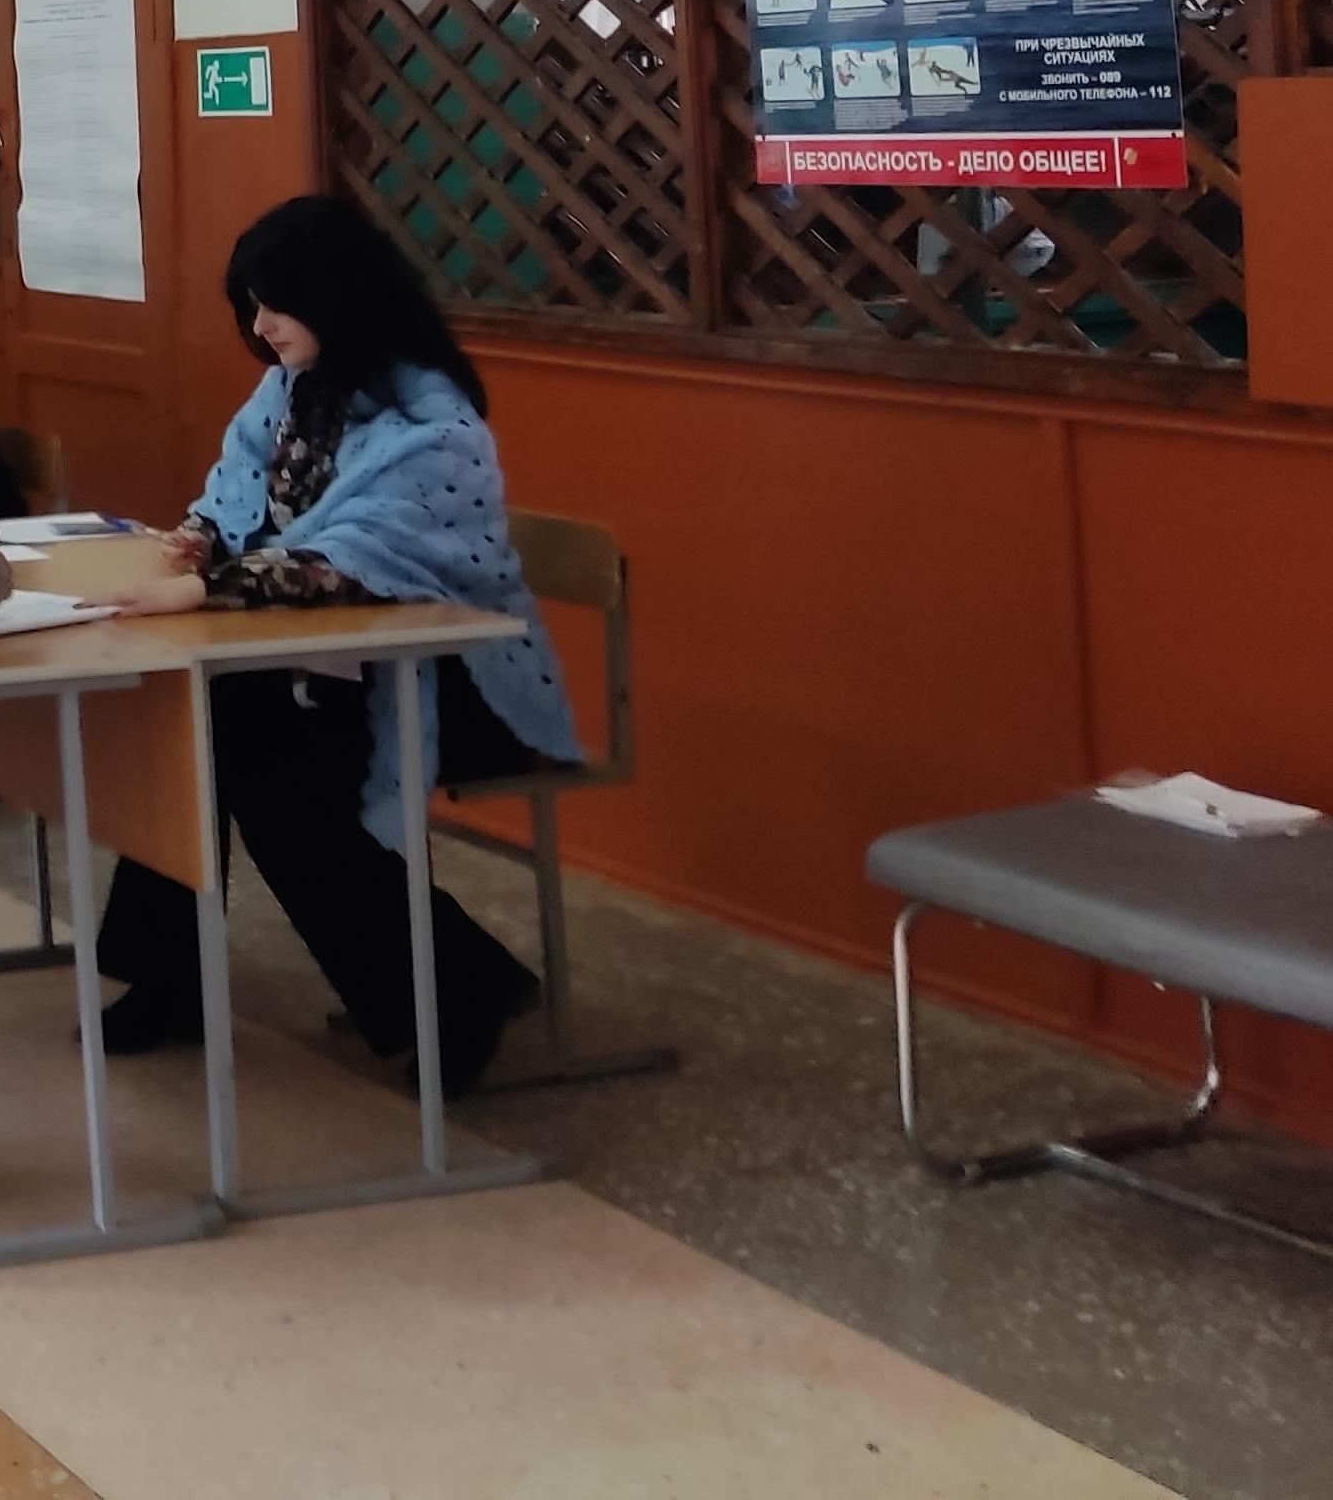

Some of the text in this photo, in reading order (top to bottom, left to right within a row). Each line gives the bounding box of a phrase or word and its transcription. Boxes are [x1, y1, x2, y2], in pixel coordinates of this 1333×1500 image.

[1015, 32, 1146, 52] ПРИ ЧРЕЗВЫЧАЙНЫХ
[1043, 49, 1117, 66] СИТУАЦИЯХ
[1041, 72, 1090, 85] ЗВОНИТЬ
[998, 90, 1007, 102] С
[1008, 88, 1078, 102] МОБИЛЬНОГО
[1079, 86, 1139, 100] ТЕЛЕФОНА
[1149, 85, 1172, 99] 112
[793, 149, 942, 173] БЕЗОПАСНОСТЬ
[958, 150, 1015, 175] ДЕЛО
[1019, 148, 1107, 175] ОБЩЕЕ!
